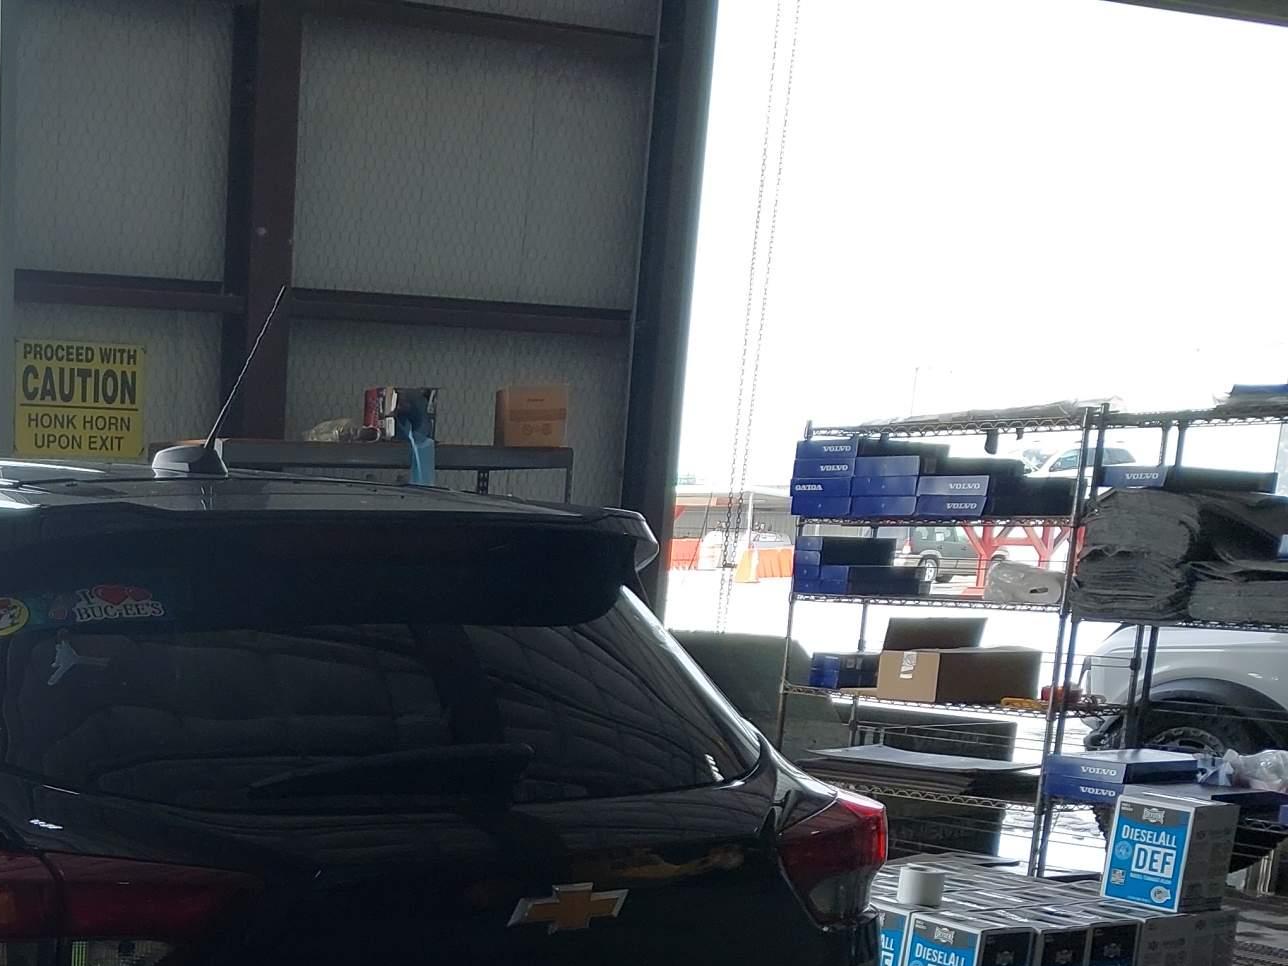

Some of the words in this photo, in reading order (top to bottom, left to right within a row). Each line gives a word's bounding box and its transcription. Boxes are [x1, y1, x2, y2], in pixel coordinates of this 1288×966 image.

[23, 343, 94, 363] PROCEED
[99, 347, 137, 365] WITH
[22, 365, 137, 405] CAUTION
[27, 413, 77, 430] HONK
[82, 415, 131, 432] HORN
[34, 433, 82, 450] UPON
[88, 436, 125, 452] EXIT
[822, 445, 852, 453] VOLVO
[819, 464, 849, 472] VOLVO
[946, 502, 978, 510] VOLVO
[1080, 765, 1117, 777] VOLVO
[1079, 786, 1116, 797] VOLVO
[1134, 847, 1174, 875] DEF
